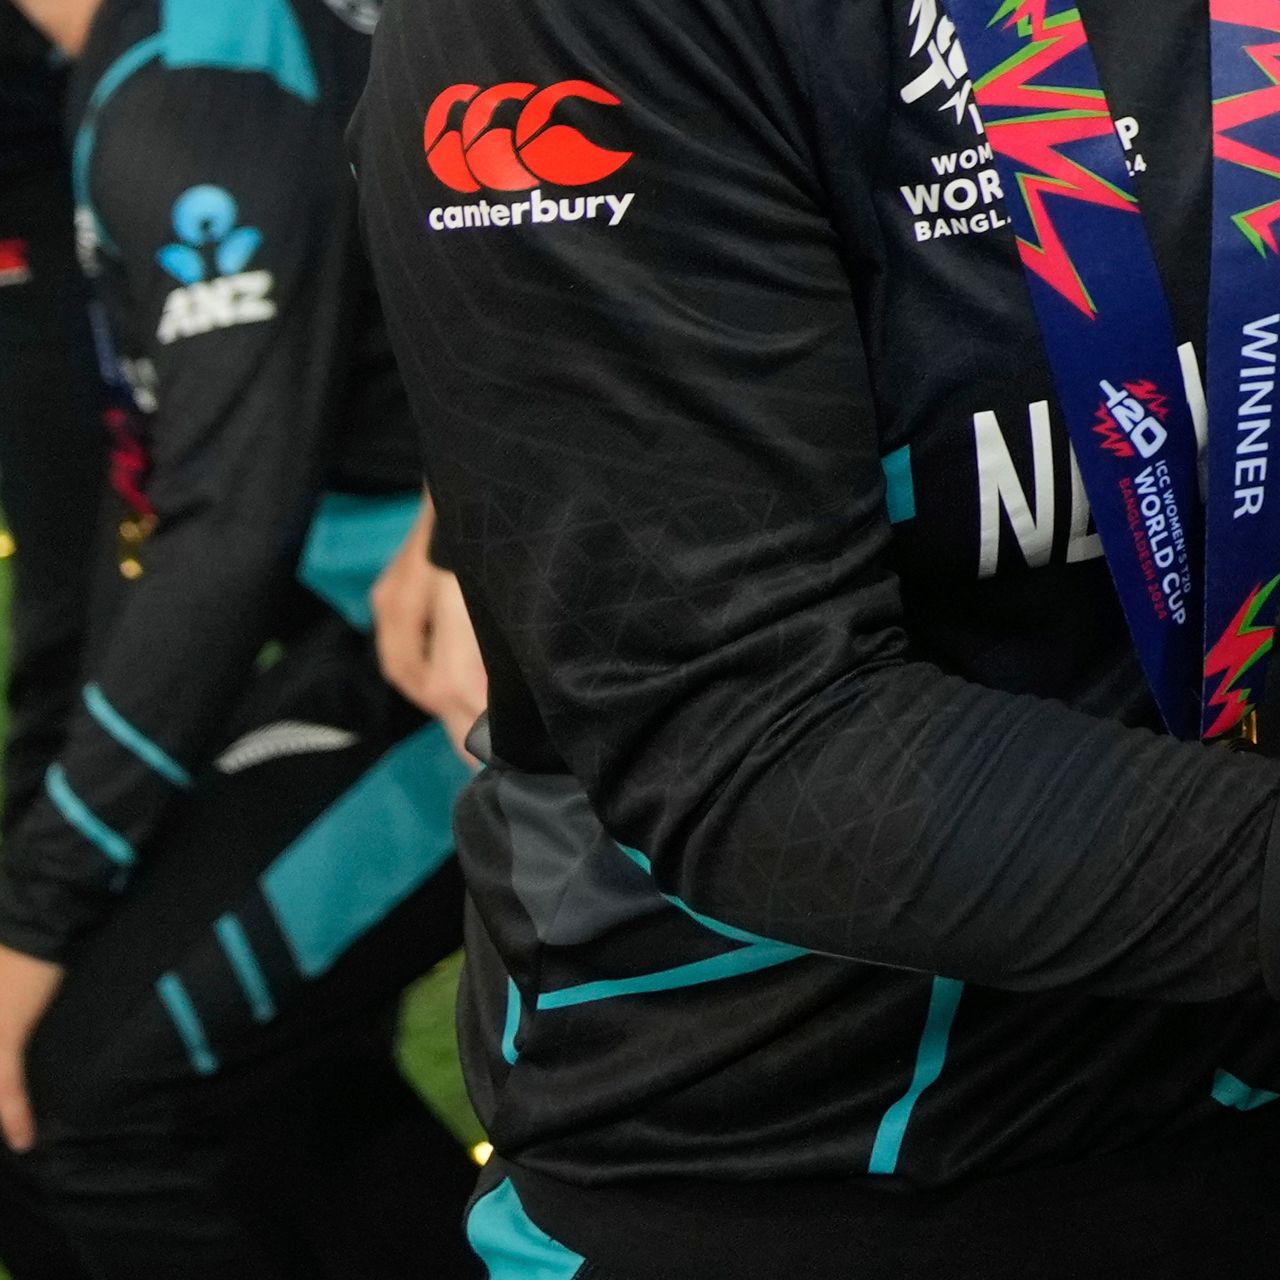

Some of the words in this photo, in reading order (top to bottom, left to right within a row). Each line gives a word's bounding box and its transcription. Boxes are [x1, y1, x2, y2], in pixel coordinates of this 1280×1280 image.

[428, 190, 635, 231] canterbury
[900, 169, 1004, 216] WOR
[914, 209, 1012, 242] BANGL
[1099, 379, 1169, 459] T20
[1233, 313, 1280, 519] WINNER
[1154, 459, 1172, 489] ICC
[1119, 477, 1152, 582] BANGLADESH
[1134, 465, 1175, 569] WORLD
[1162, 571, 1187, 625] CUP
[1162, 488, 1188, 565] WOMEN'S
